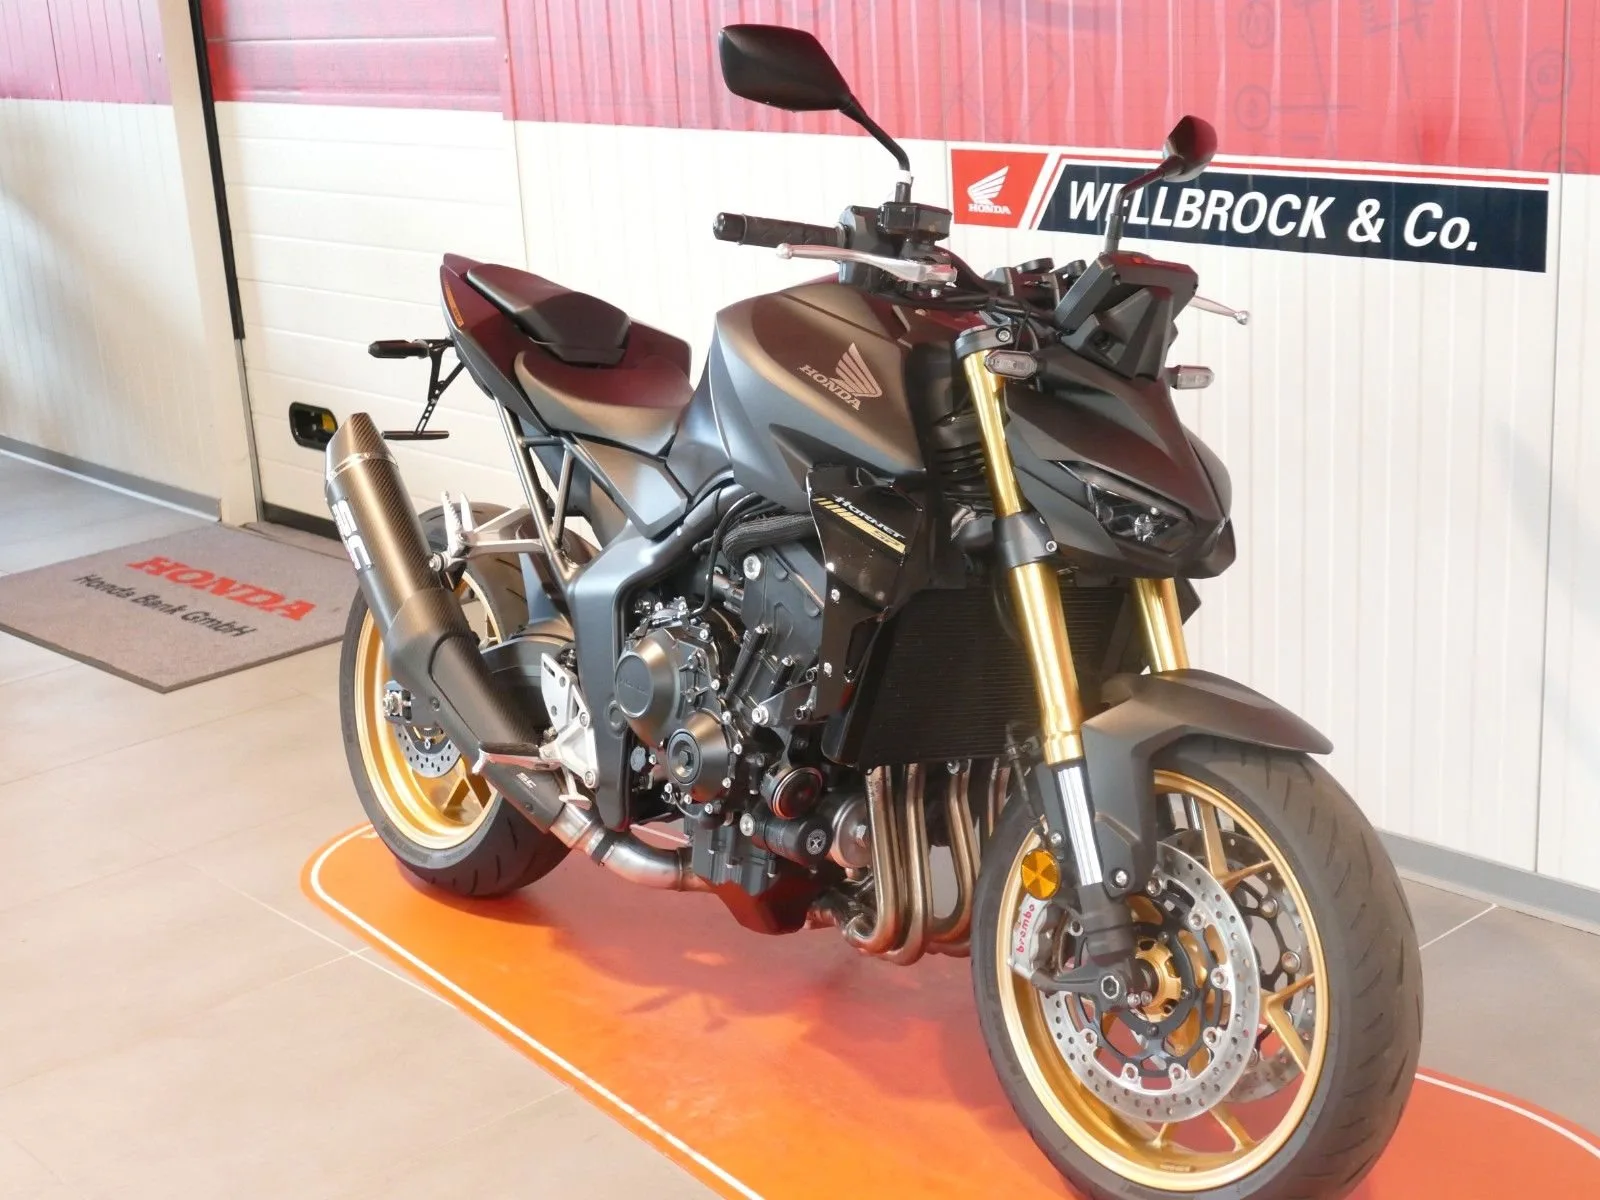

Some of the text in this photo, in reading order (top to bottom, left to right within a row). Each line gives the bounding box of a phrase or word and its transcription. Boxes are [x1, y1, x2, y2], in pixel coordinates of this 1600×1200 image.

[967, 203, 1012, 215] HONDA
[1069, 180, 1478, 251] WELLBROCK & Co.
[798, 365, 861, 410] HONDA
[73, 573, 257, 637] Honda Bank GmbH
[126, 555, 316, 621] HONDA
[1015, 903, 1035, 953] brembo
